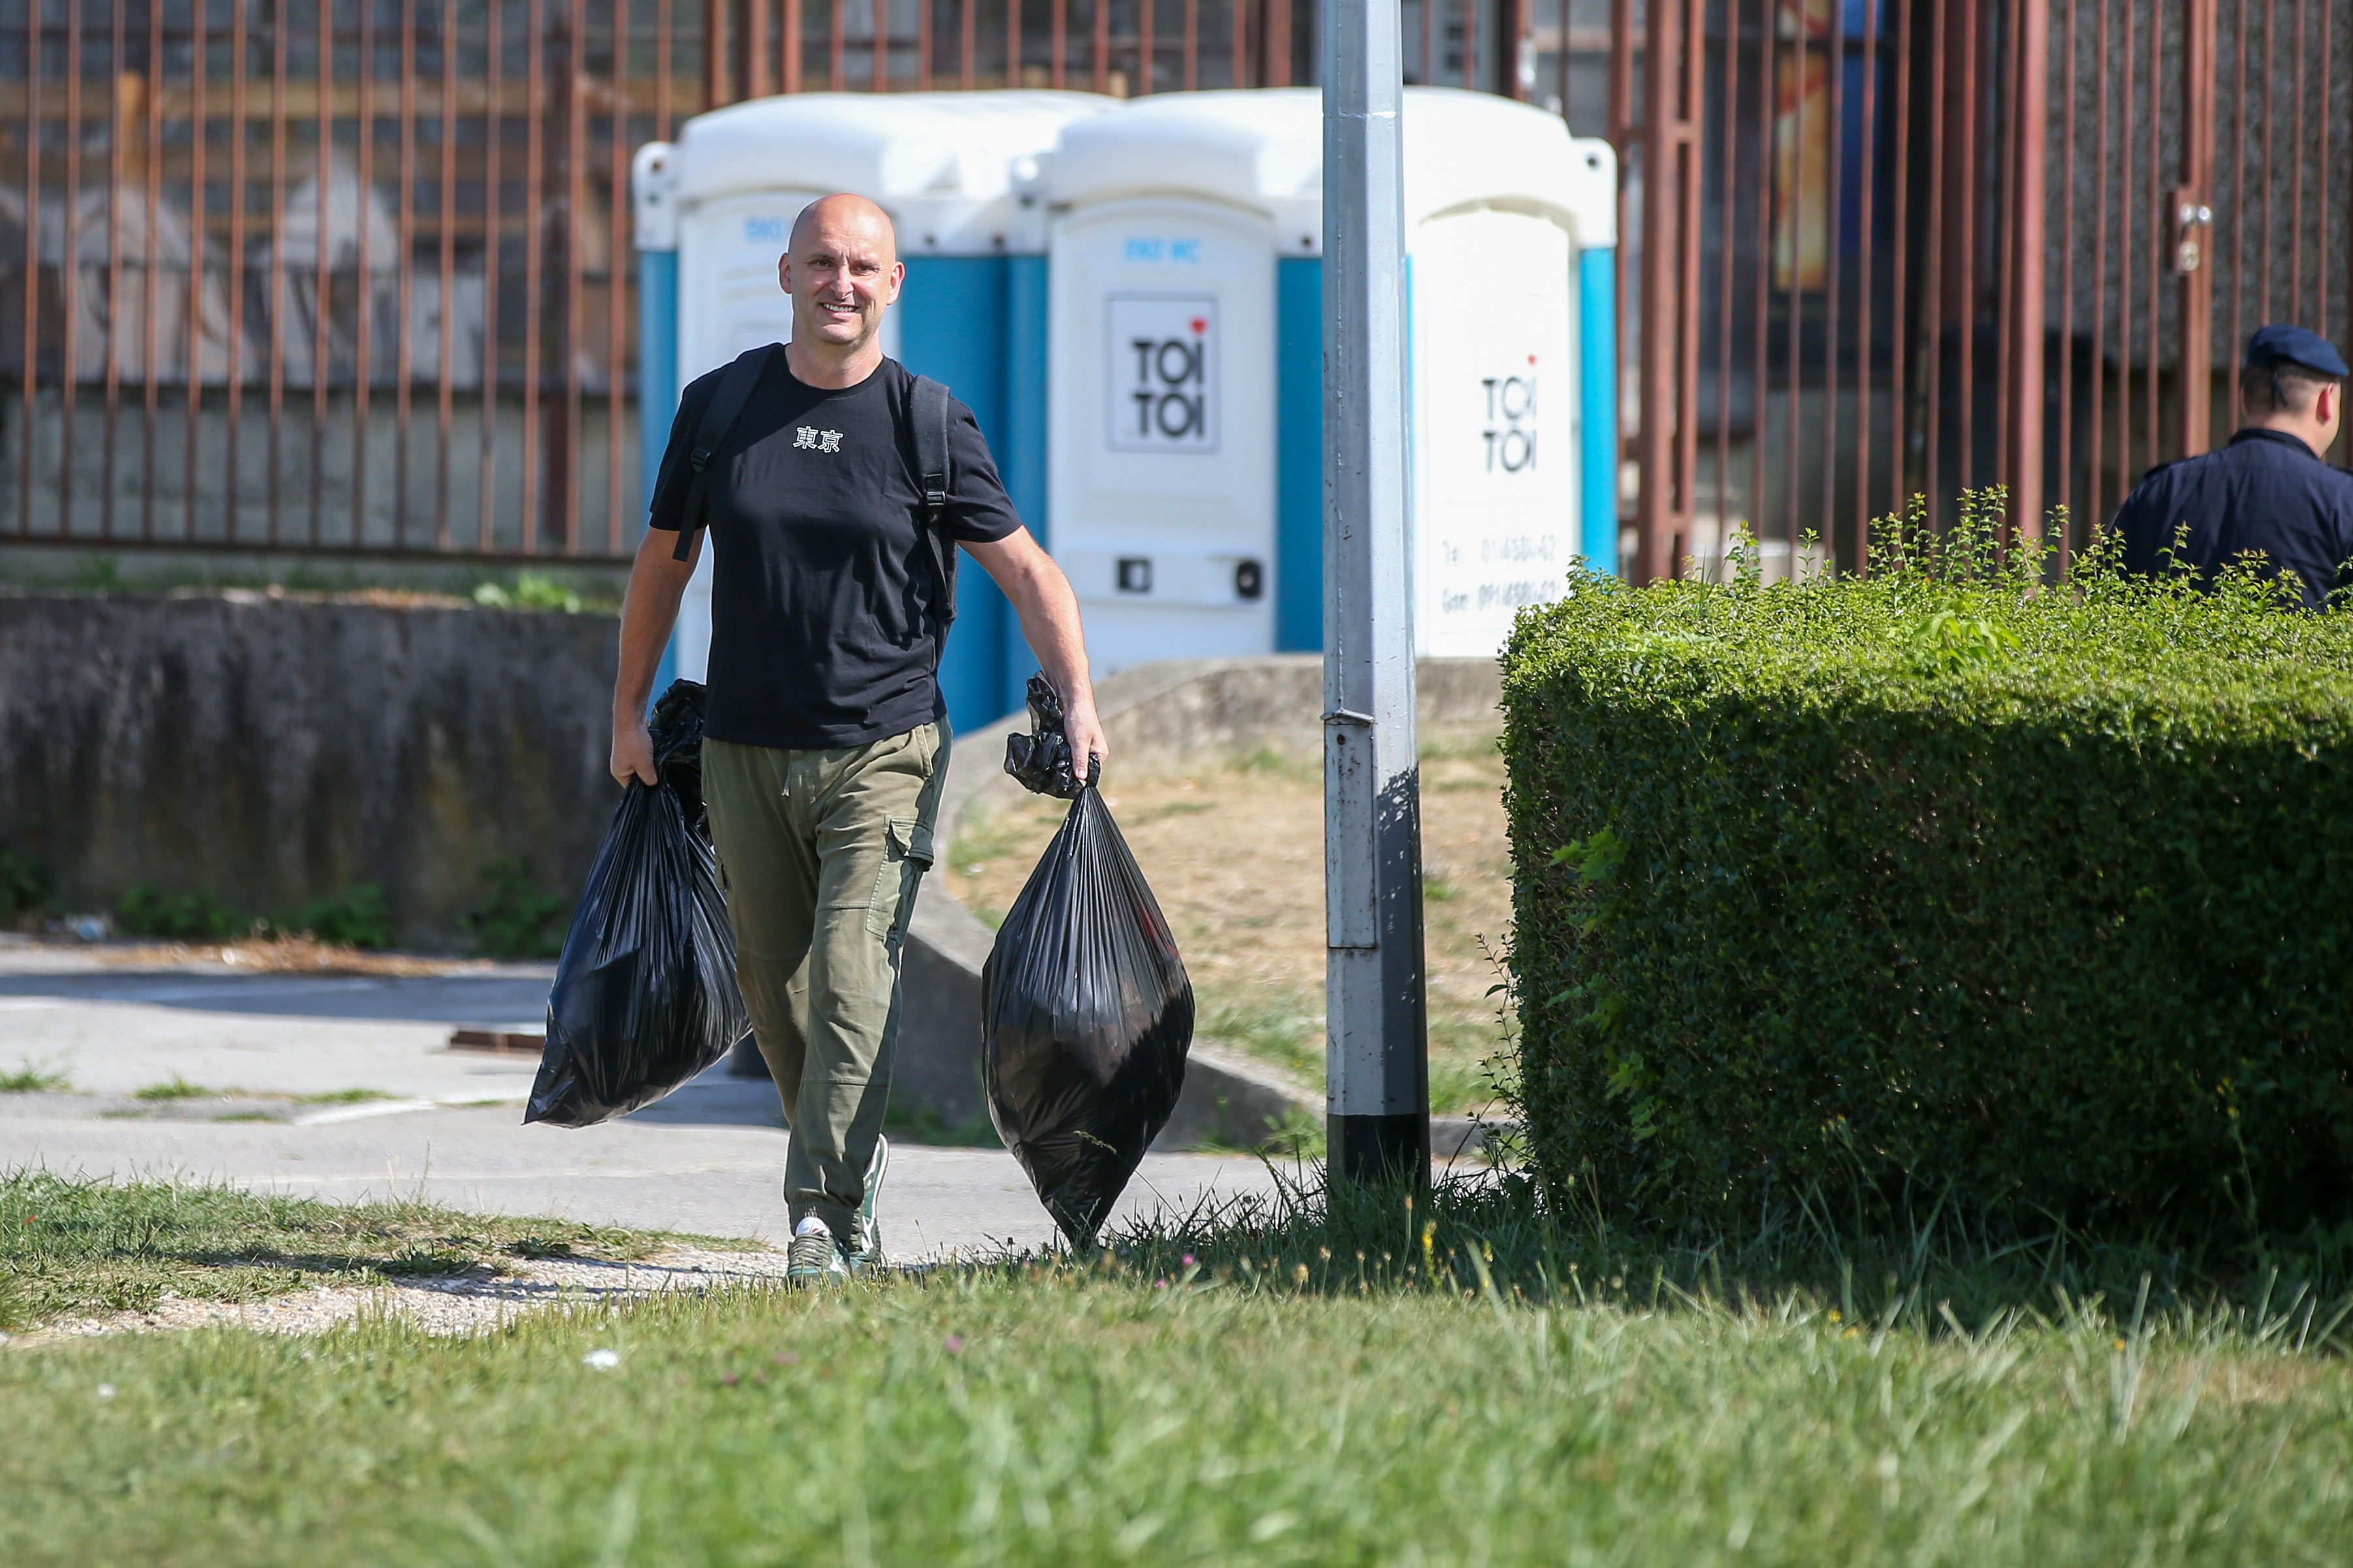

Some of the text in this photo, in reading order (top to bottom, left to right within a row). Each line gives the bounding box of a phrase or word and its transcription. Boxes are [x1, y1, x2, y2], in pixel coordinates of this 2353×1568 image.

[1131, 338, 1205, 386] TOI
[1131, 390, 1205, 439] TOI
[793, 426, 844, 453] 東京
[1481, 428, 1537, 475] TOI
